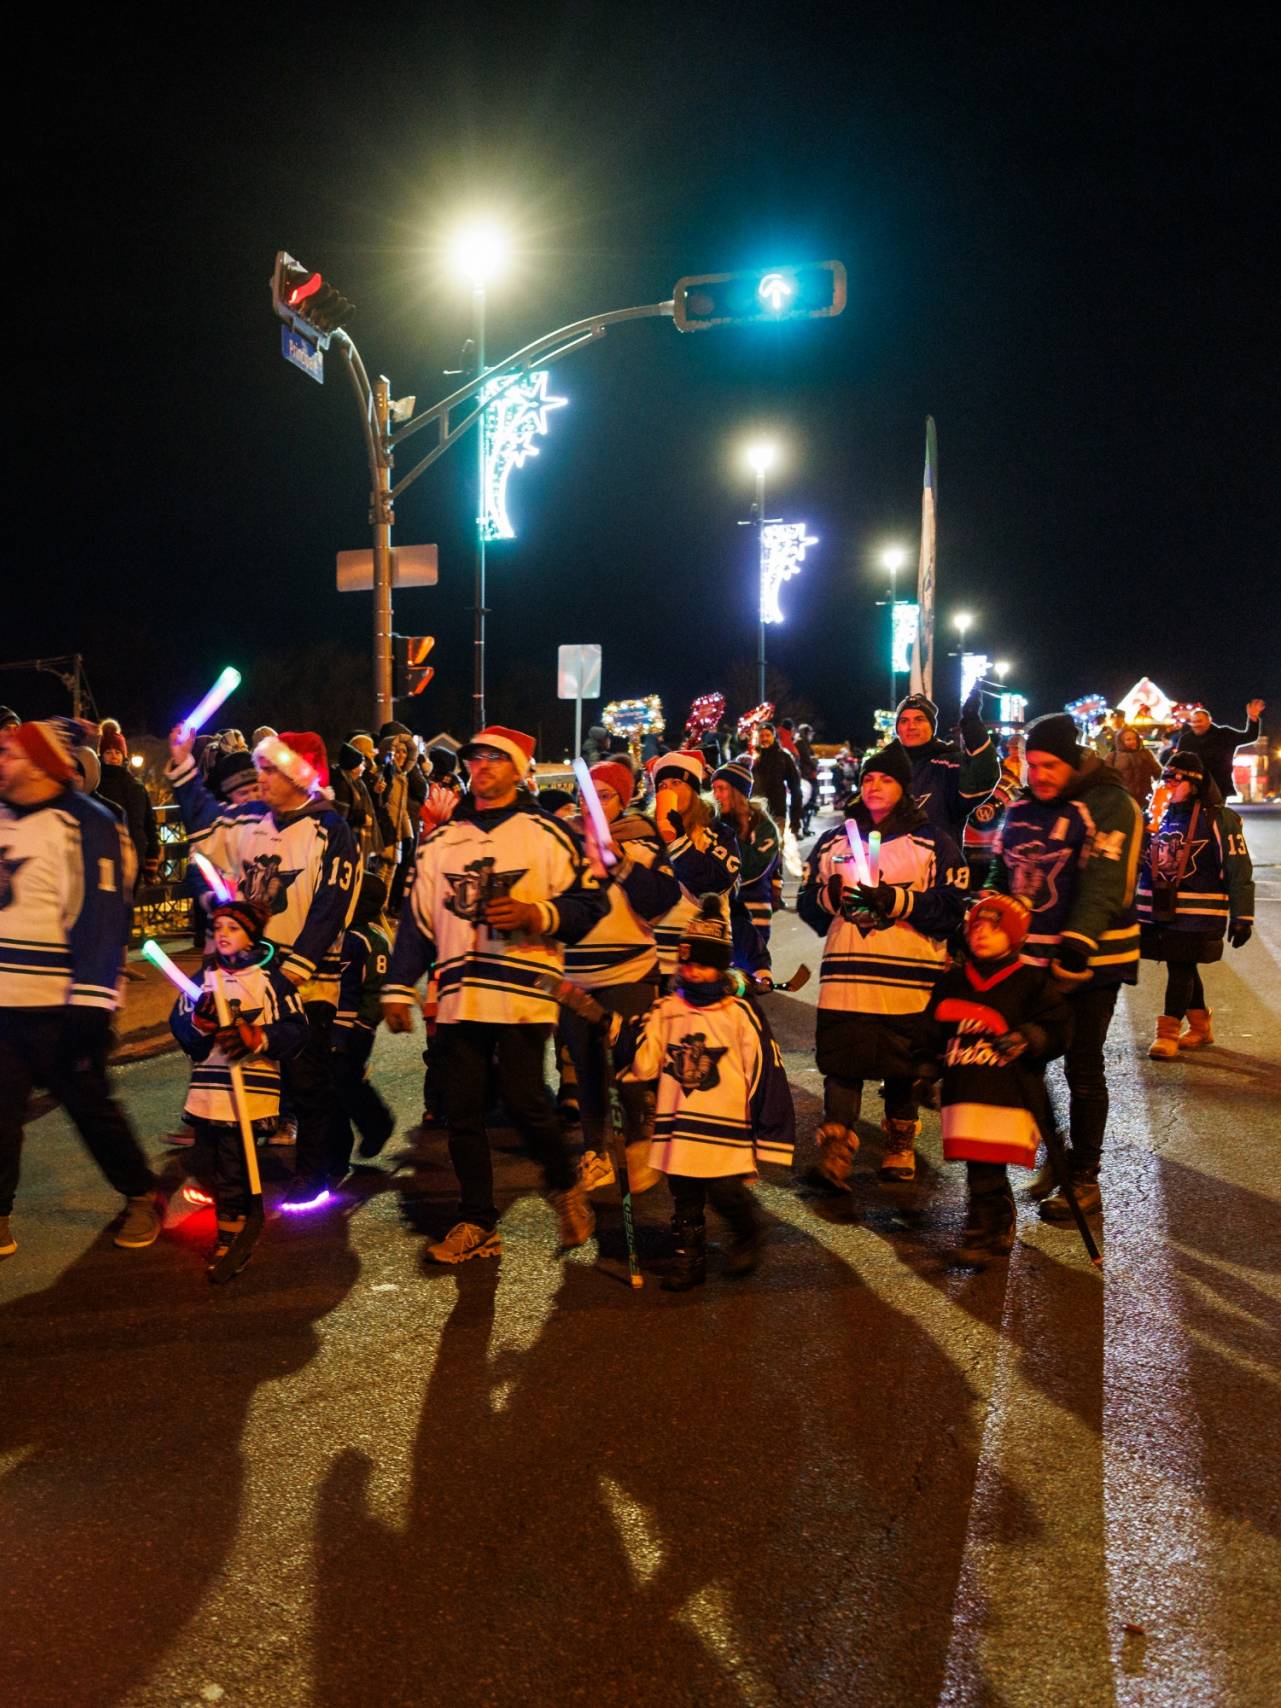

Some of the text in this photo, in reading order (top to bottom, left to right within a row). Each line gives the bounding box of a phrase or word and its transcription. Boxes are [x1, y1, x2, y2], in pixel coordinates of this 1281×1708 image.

[1227, 833, 1247, 856] 13
[327, 856, 353, 891] 13
[376, 954, 388, 975] 8
